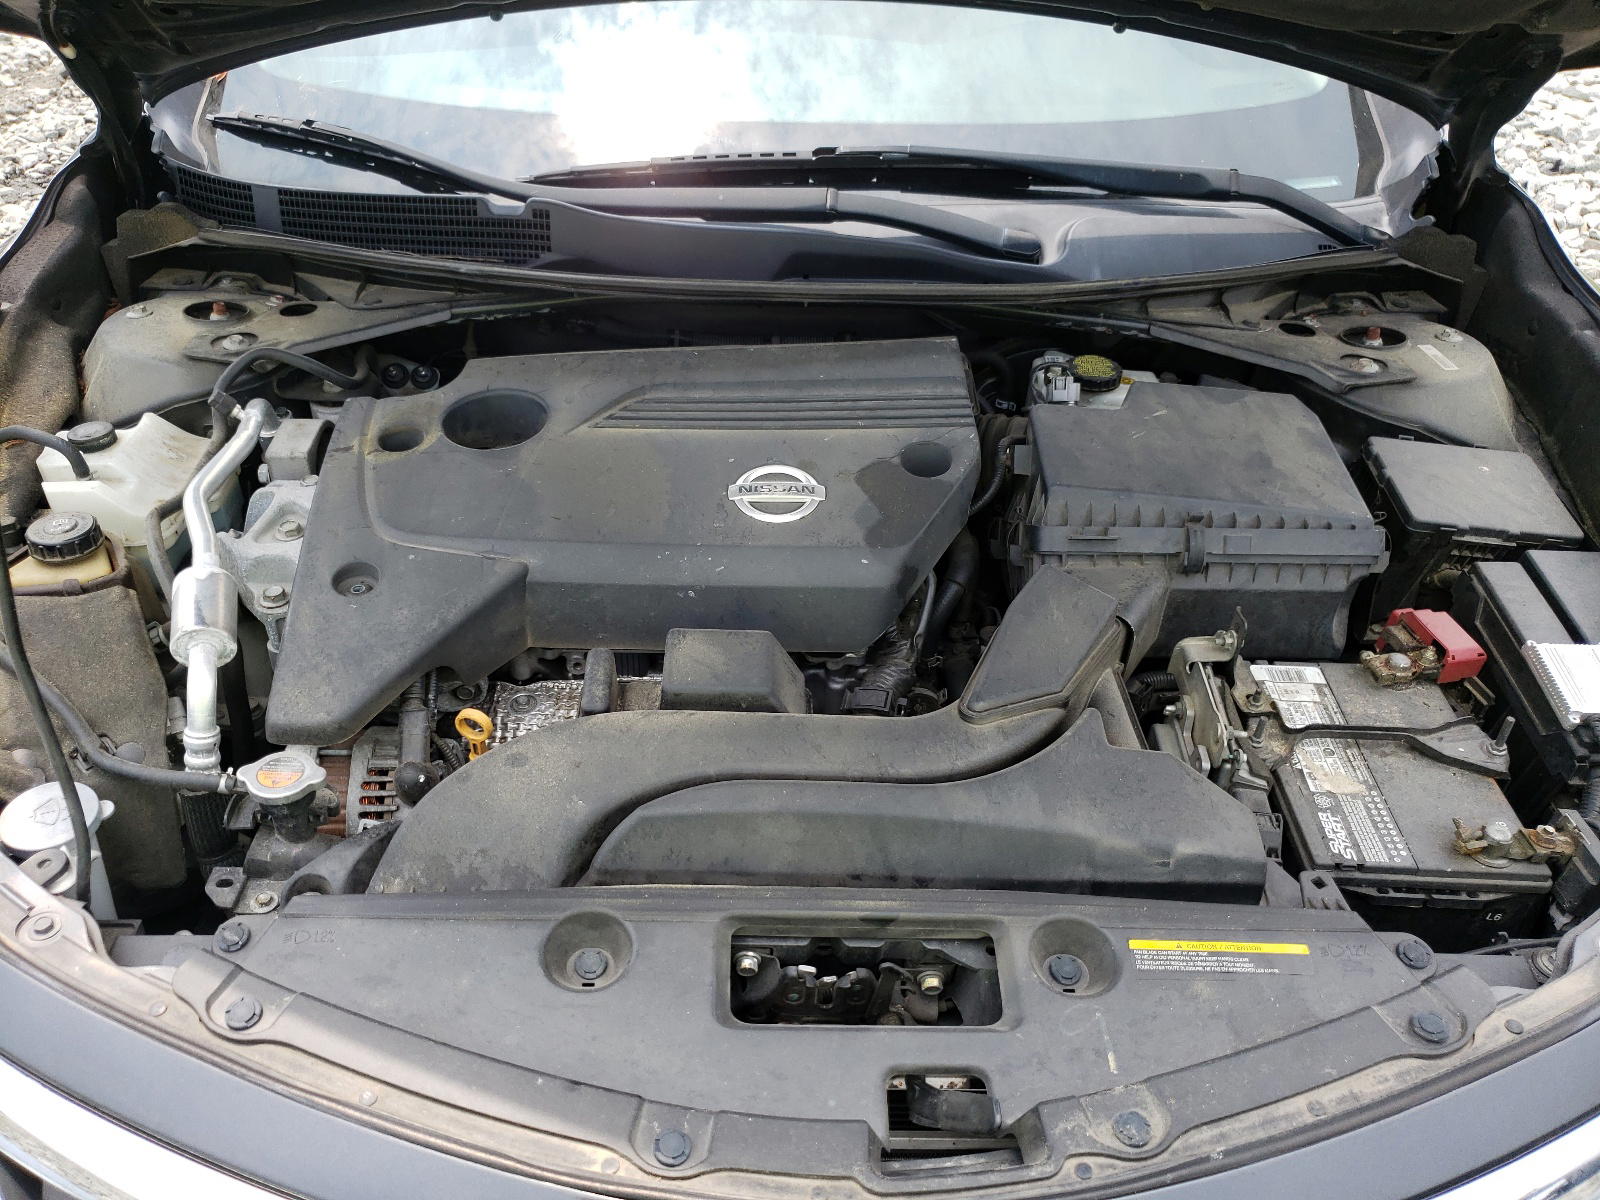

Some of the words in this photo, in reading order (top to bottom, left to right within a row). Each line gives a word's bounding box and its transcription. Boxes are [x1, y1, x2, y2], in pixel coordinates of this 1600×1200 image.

[739, 485, 815, 494] NISSAN
[1318, 812, 1341, 854] SUPER
[1330, 814, 1357, 861] START
[1486, 912, 1503, 920] L6
